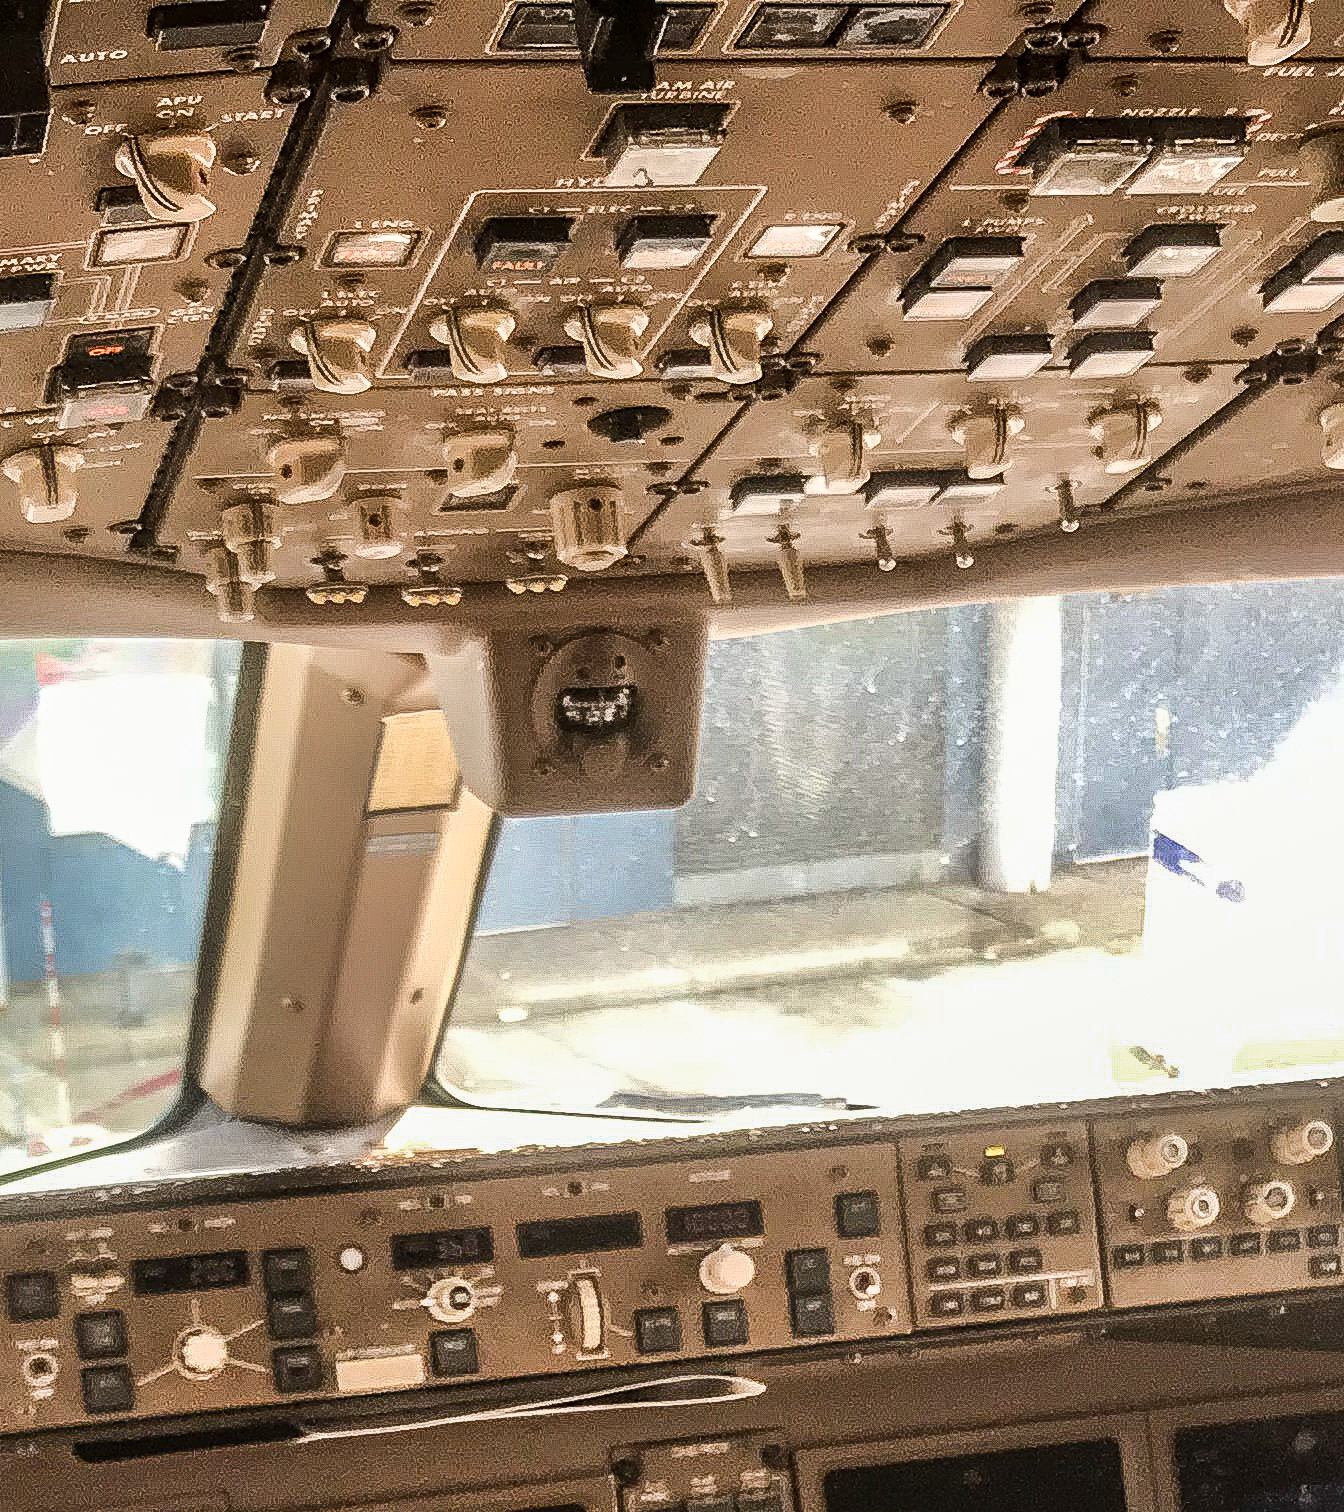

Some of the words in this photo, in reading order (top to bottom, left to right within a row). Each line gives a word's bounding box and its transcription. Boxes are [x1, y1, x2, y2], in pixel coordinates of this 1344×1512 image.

[61, 50, 127, 62] AUTO
[157, 94, 202, 107] APU
[220, 109, 285, 122] START
[84, 123, 127, 135] OFF
[89, 346, 124, 355] OFF
